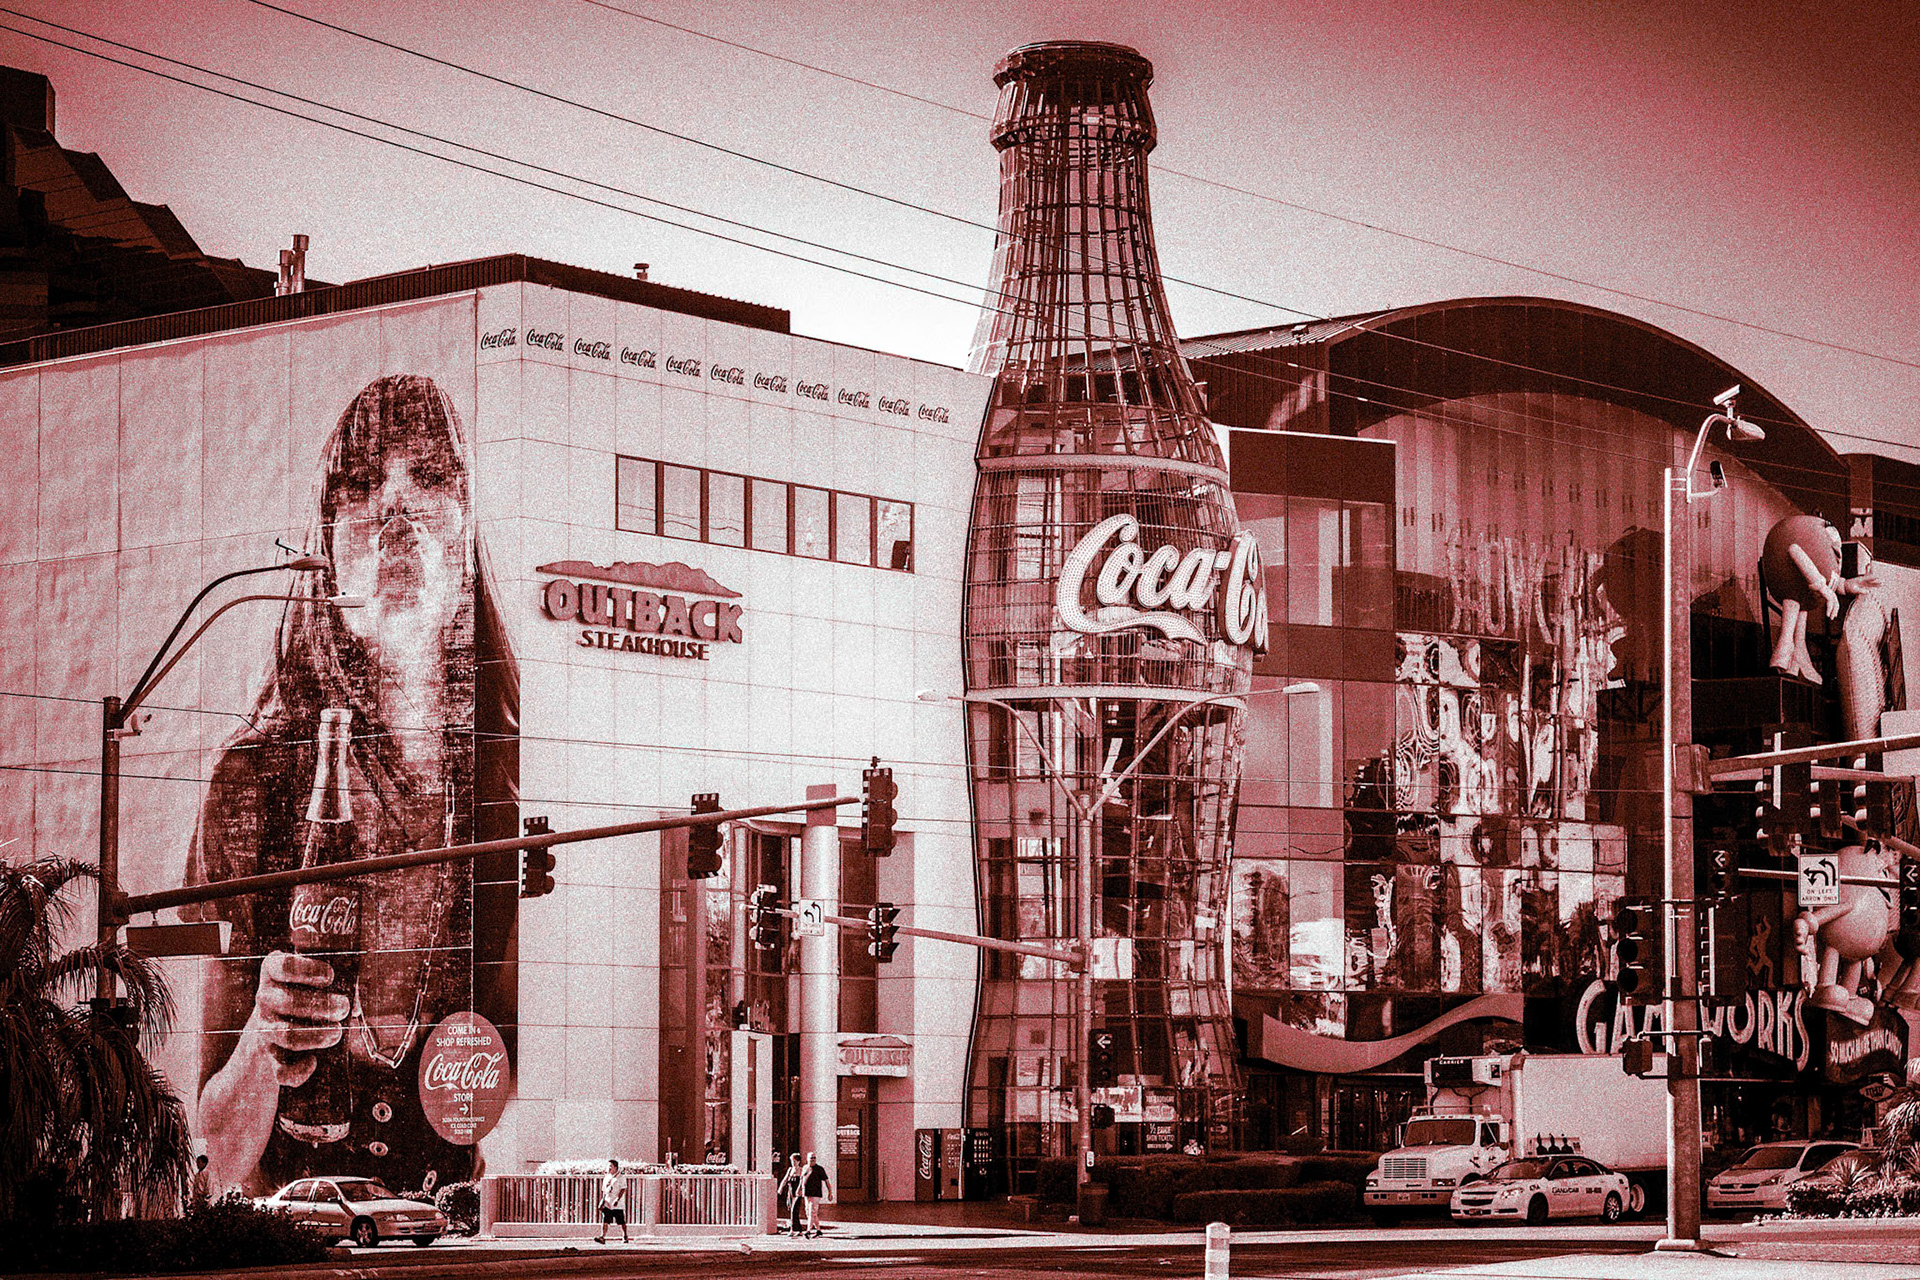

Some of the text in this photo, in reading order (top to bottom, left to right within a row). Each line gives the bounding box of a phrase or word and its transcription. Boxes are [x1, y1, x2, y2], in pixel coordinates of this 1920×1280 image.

[543, 579, 744, 644] OUTBACK
[580, 630, 710, 661] STEAKHOUSE
[447, 1026, 468, 1035] COME
[468, 1026, 476, 1035] IN
[1575, 978, 1810, 1072] GAMWORKS
[436, 1036, 492, 1047] SHOP REFRESHED
[1830, 1040, 1839, 1064] SO
[453, 1093, 474, 1102] STORE
